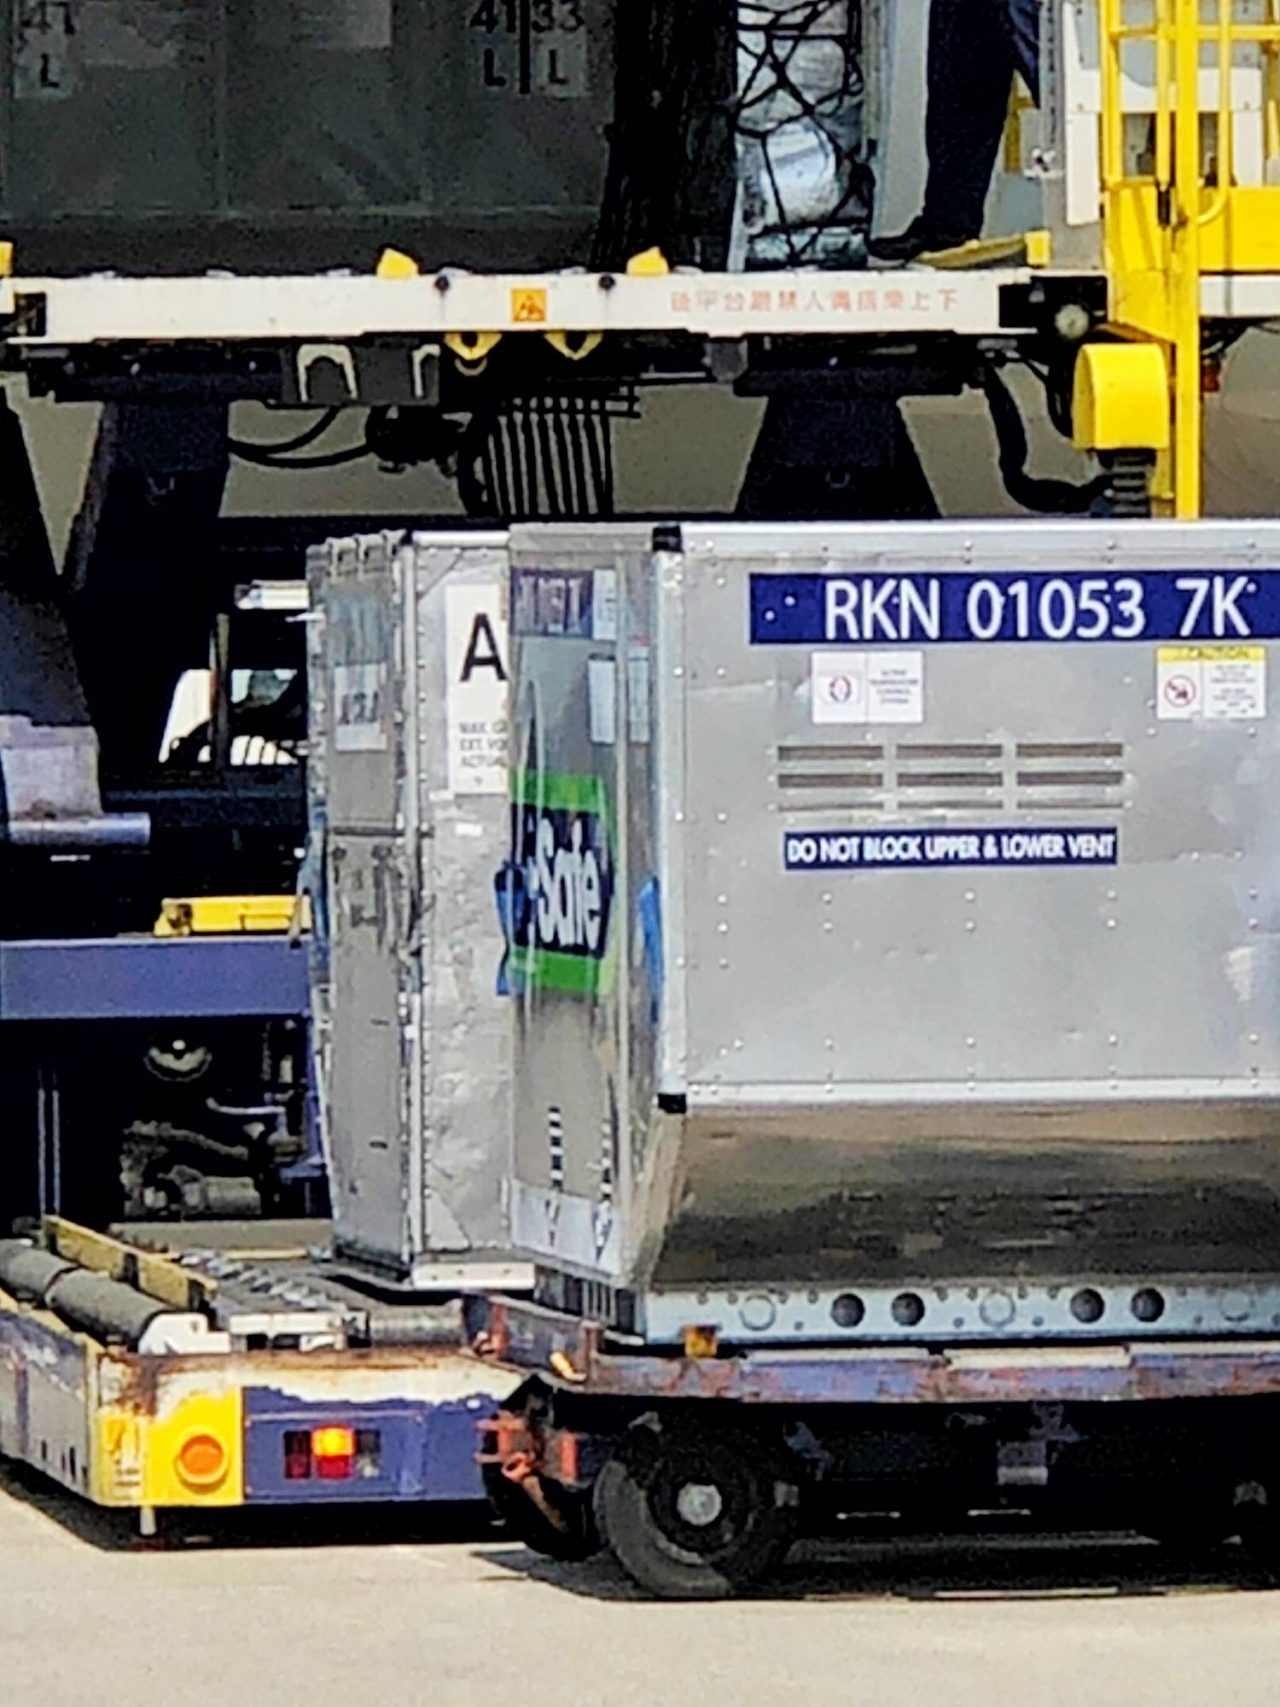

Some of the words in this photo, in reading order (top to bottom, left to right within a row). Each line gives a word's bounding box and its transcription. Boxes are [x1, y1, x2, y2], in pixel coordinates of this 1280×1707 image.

[484, 48, 506, 87] L
[548, 49, 569, 85] L
[824, 579, 940, 640] RKN
[967, 578, 1146, 639] 01053
[1175, 576, 1252, 637] 7K
[460, 613, 508, 682] A
[787, 838, 817, 863] DO
[819, 837, 861, 862] NOT
[863, 836, 922, 861] BLOCK
[924, 834, 981, 860] UPPER
[983, 834, 998, 858] &
[1001, 833, 1066, 858] LOWER
[1067, 833, 1115, 858] VENT
